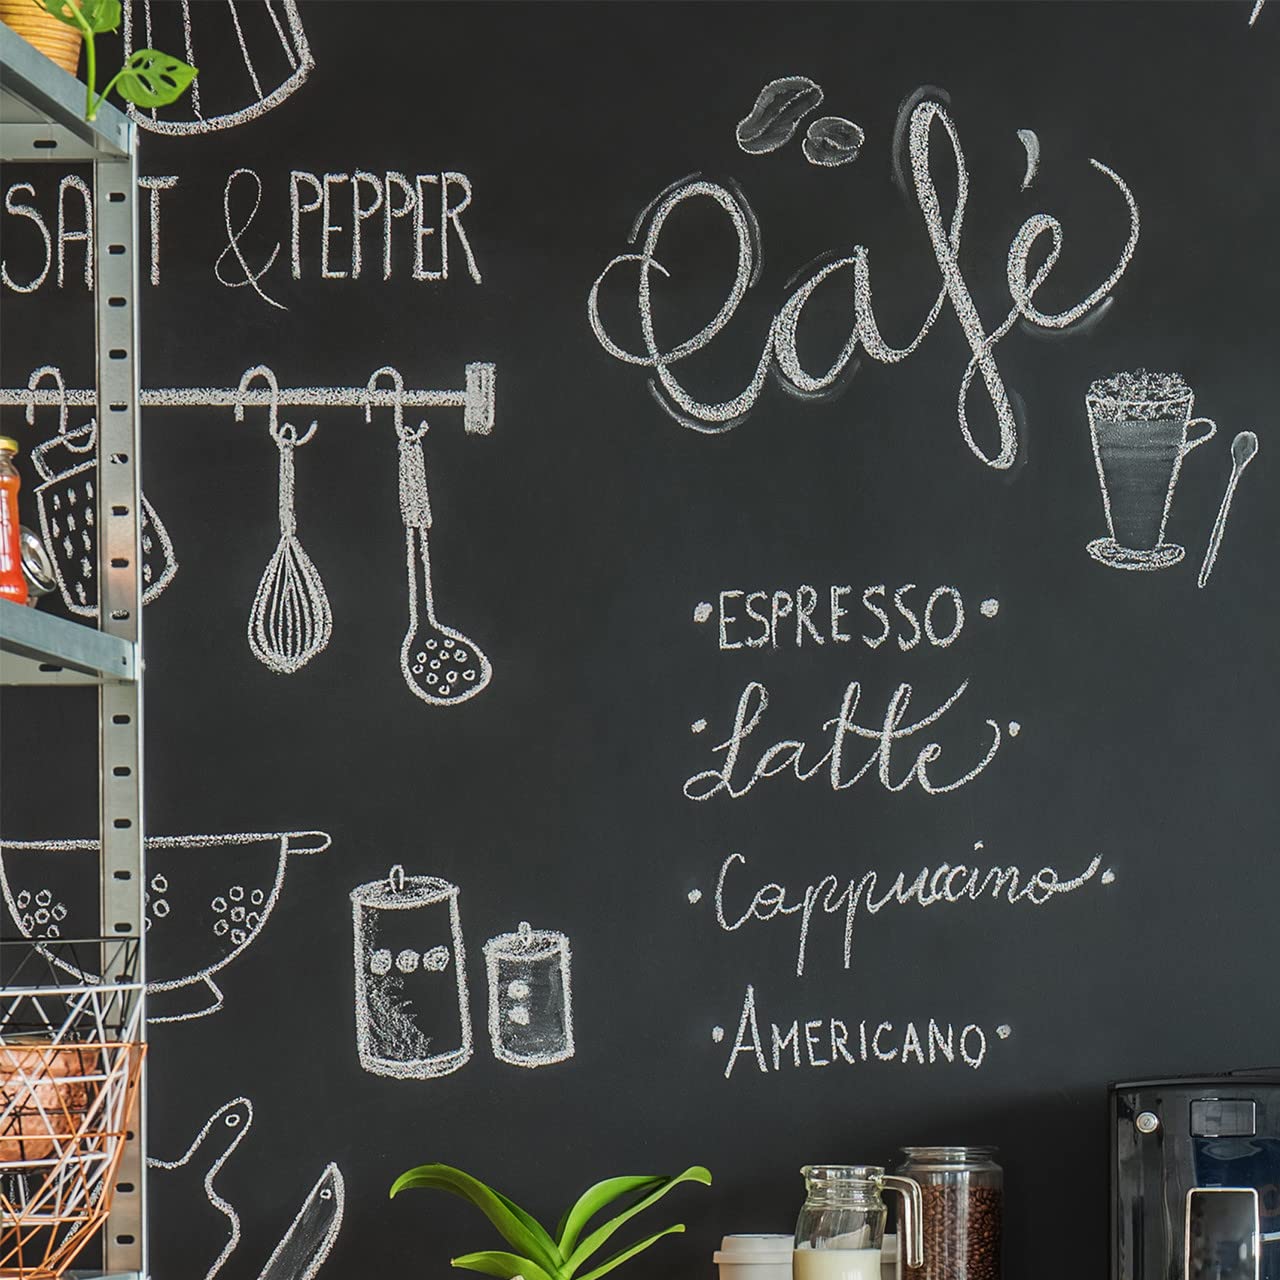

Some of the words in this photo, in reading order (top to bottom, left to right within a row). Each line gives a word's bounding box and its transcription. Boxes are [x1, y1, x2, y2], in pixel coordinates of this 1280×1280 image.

[1, 173, 179, 293] SAT
[215, 168, 289, 310] &
[290, 170, 481, 284] PEPPER
[588, 99, 1140, 470] Café
[719, 584, 964, 651] ESPRESSO
[683, 679, 1000, 801] Latte
[715, 841, 1102, 976] Cappuccino
[725, 985, 986, 1078] AMERICANO
